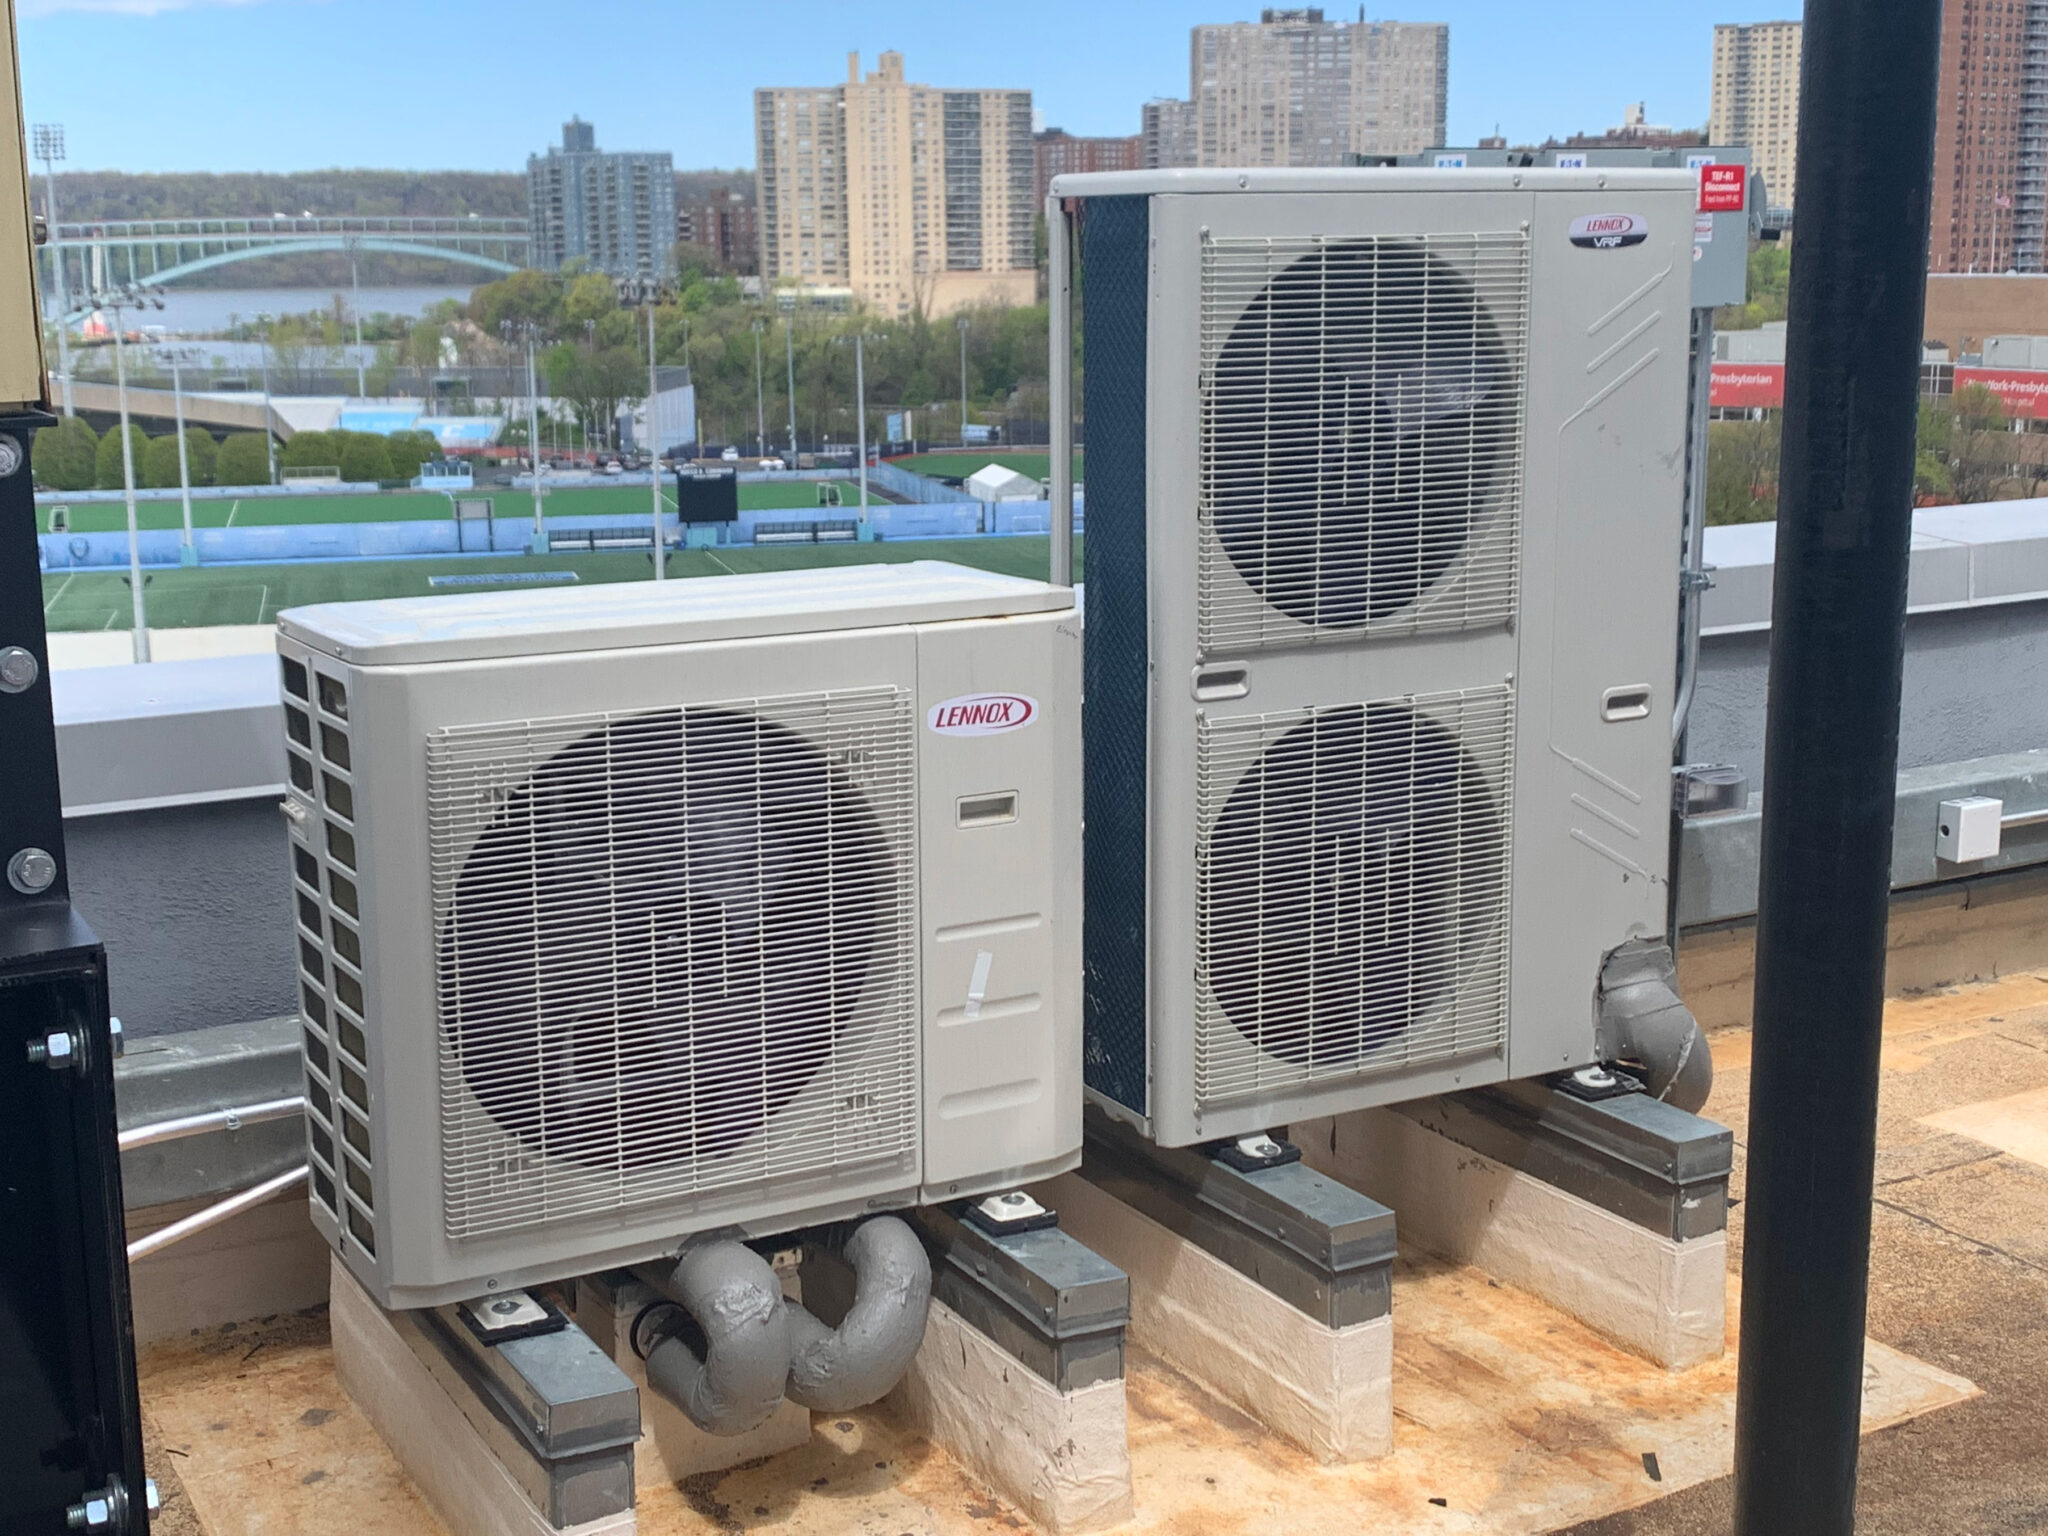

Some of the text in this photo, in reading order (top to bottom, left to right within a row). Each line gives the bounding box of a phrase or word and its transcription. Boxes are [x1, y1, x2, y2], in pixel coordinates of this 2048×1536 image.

[1704, 181, 1740, 192] Disconnect
[1586, 218, 1624, 232] LENNOX
[1593, 236, 1622, 247] VRF
[935, 702, 1014, 728] LENNOX
